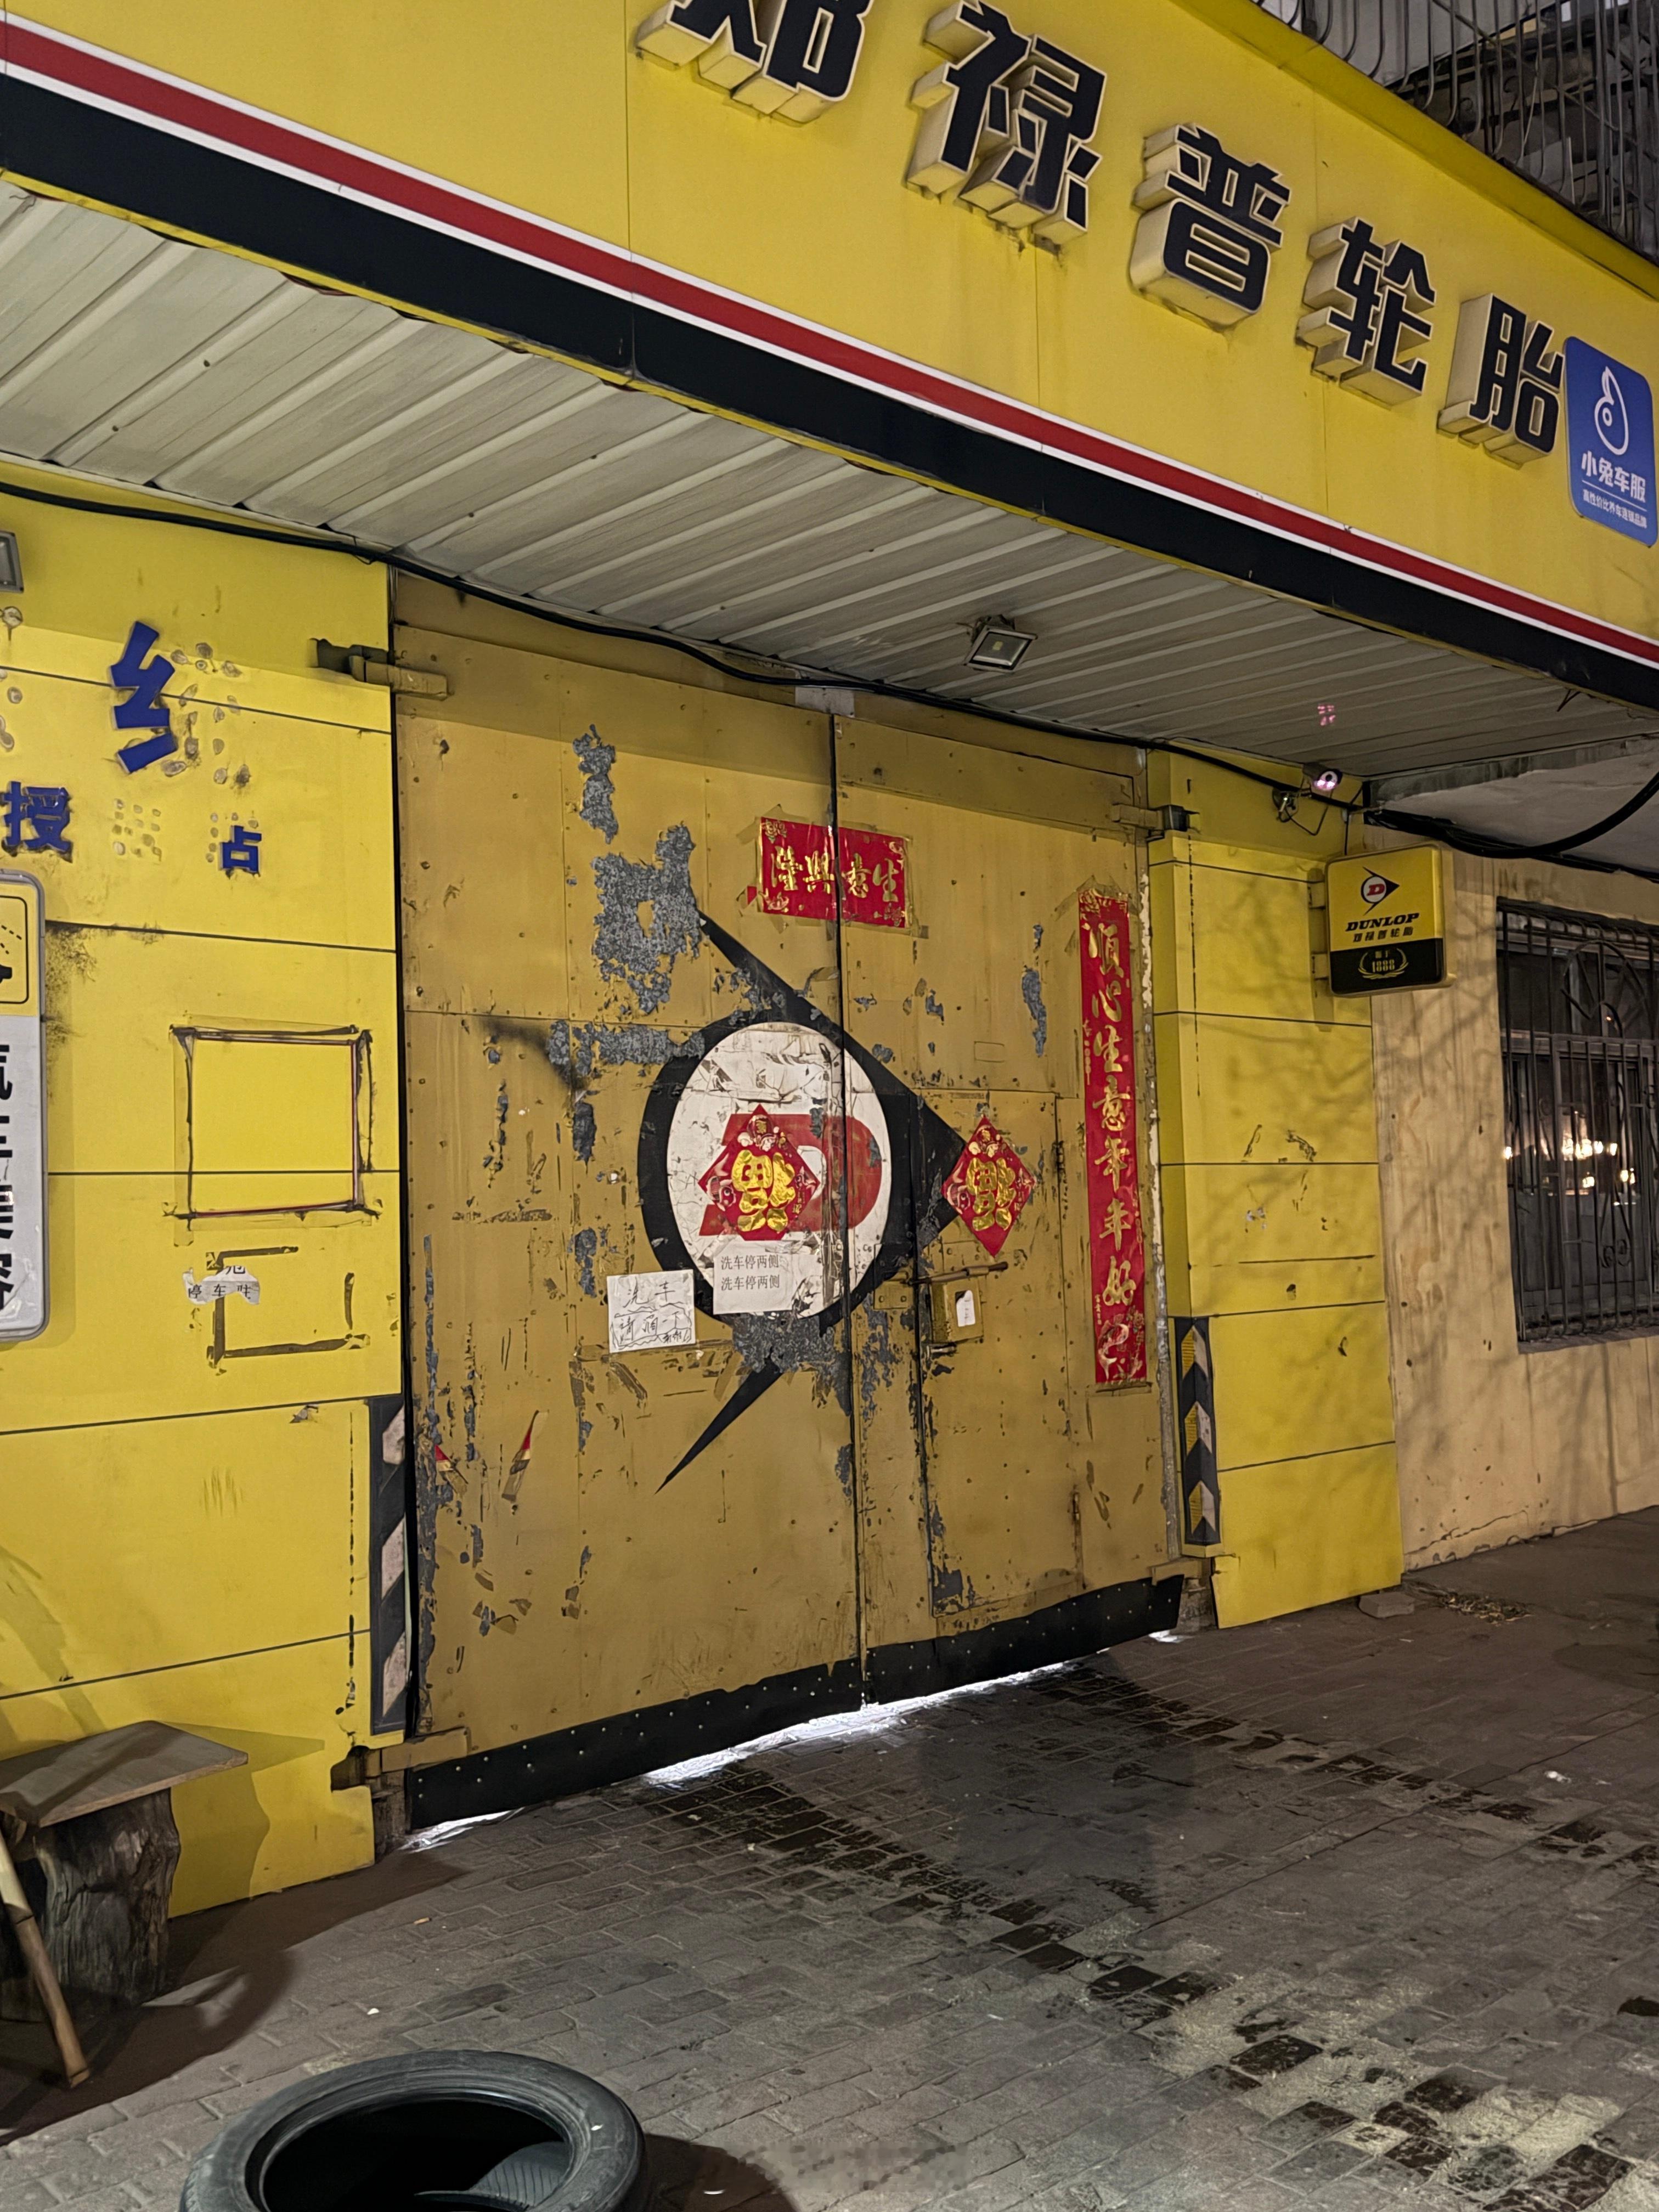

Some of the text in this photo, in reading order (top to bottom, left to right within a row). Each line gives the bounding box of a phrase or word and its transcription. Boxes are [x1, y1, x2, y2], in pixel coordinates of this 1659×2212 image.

[1345, 913, 1420, 932] DUNLOP
[720, 1254, 779, 1270] 洗车停两侧
[721, 1274, 780, 1291] 洗车停两侧
